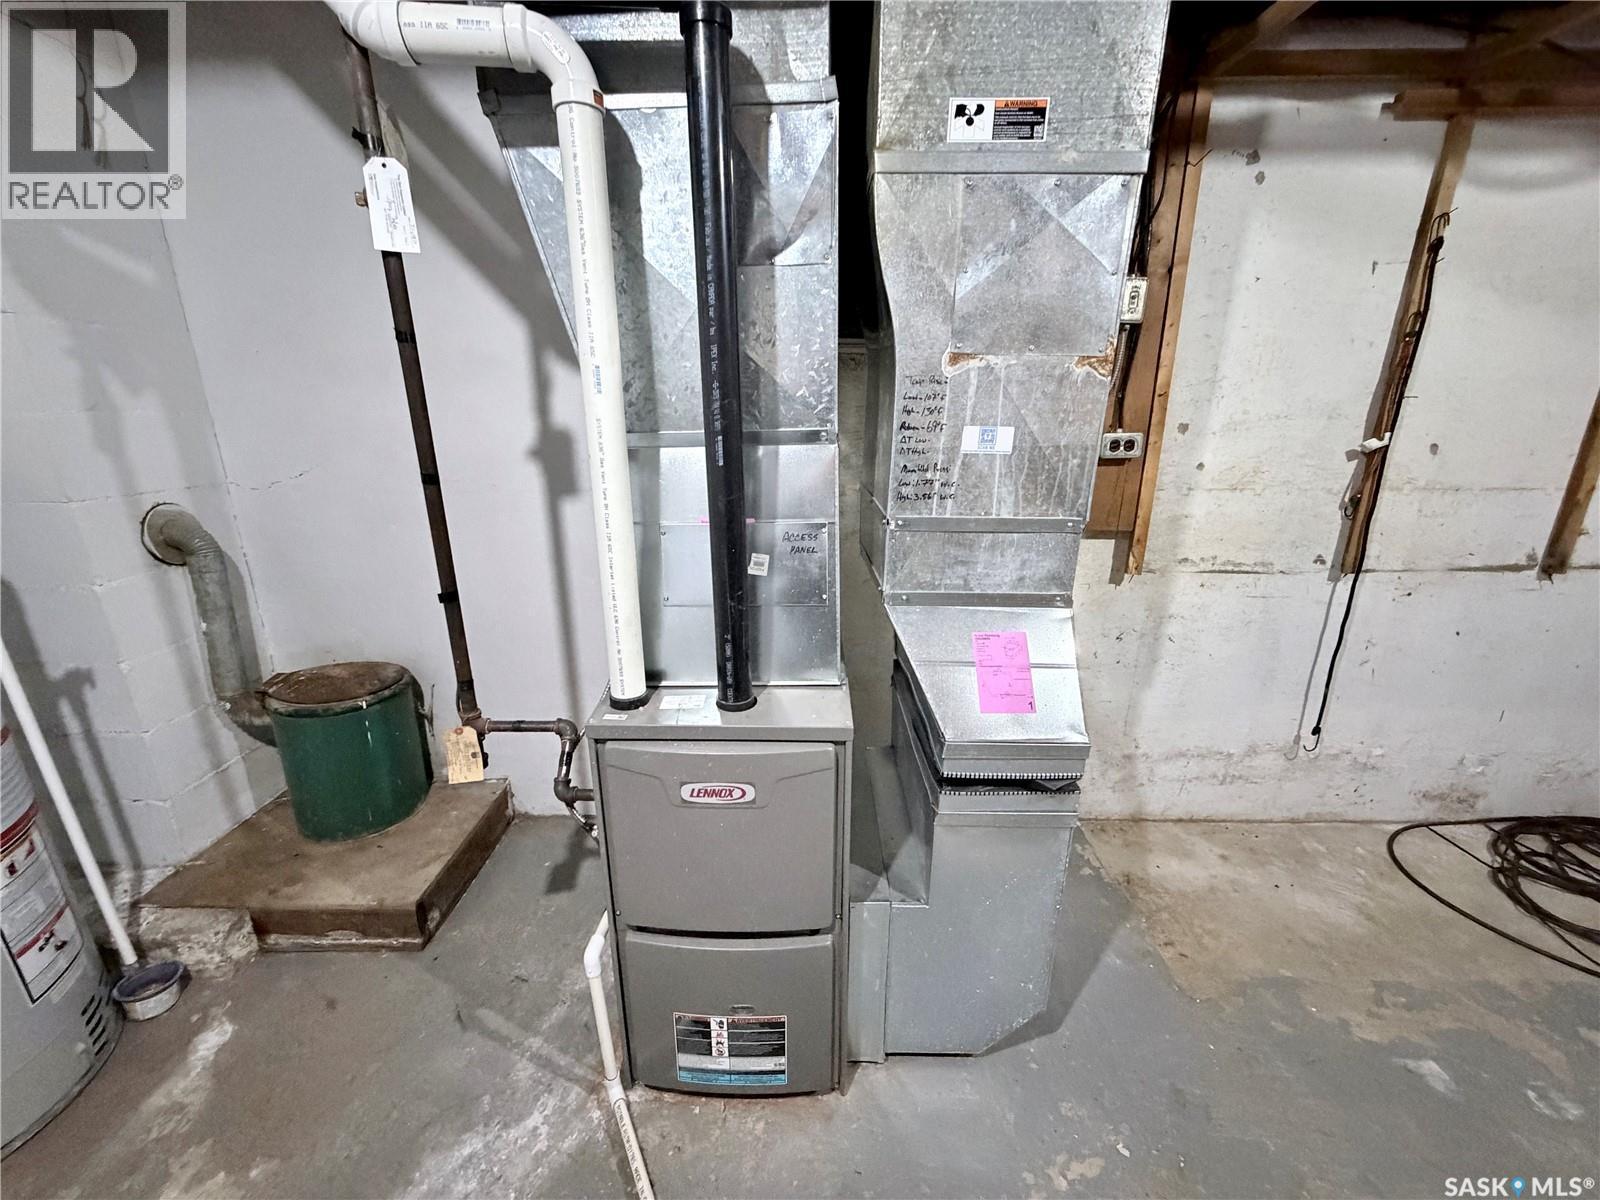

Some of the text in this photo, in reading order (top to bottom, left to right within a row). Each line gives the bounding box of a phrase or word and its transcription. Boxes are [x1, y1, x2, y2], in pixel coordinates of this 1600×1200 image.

[782, 532, 819, 543] ACCESS
[790, 546, 818, 554] PANEL
[689, 788, 735, 798] LENNOX
